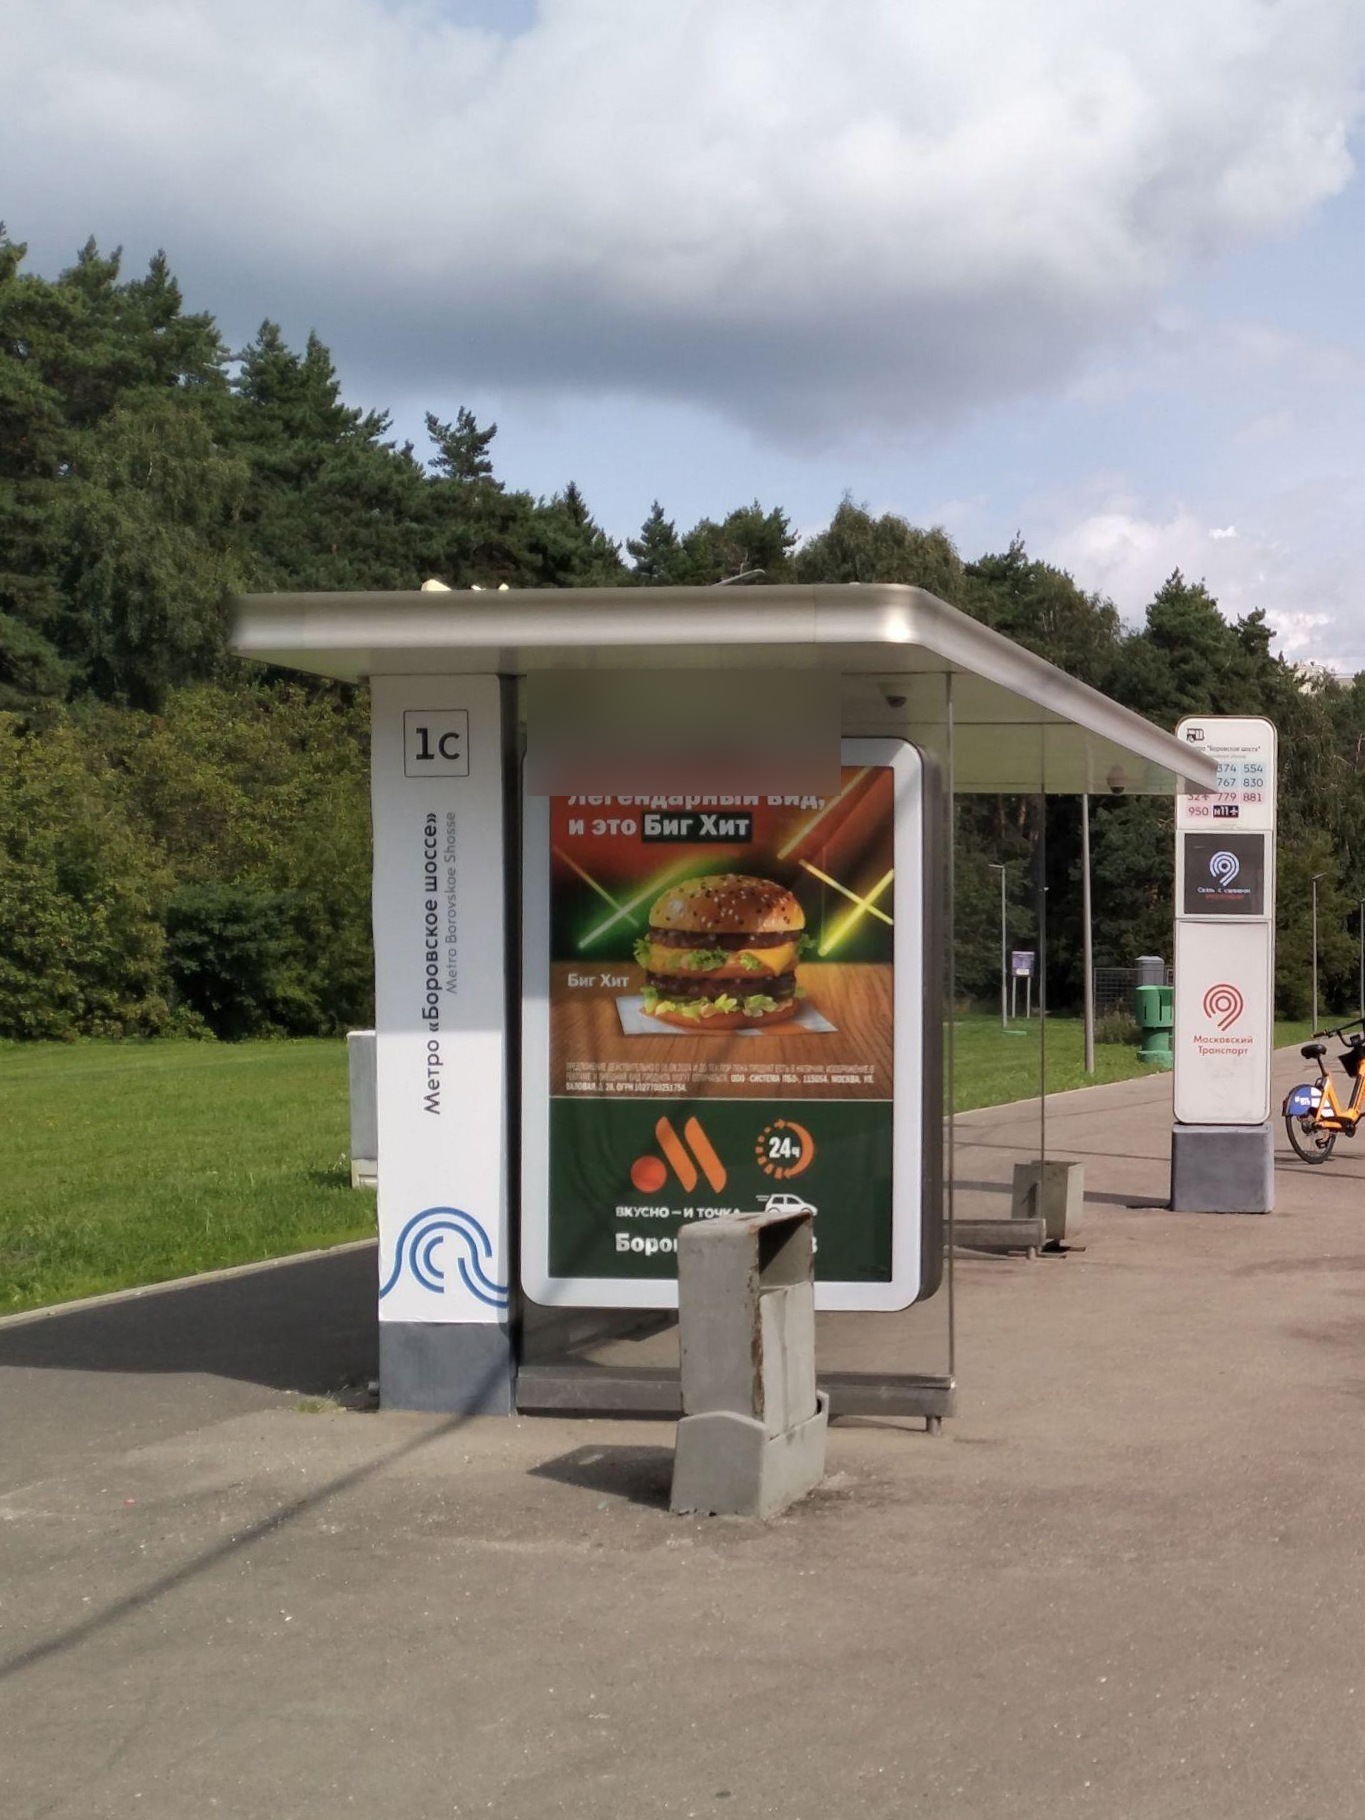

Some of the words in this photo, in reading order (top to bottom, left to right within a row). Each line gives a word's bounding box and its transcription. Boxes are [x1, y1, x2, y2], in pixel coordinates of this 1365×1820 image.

[1243, 764, 1263, 773] 554
[1217, 778, 1236, 787] 767
[1243, 778, 1264, 787] 830
[1218, 792, 1237, 801] 779
[1243, 793, 1263, 802] 881
[1188, 806, 1209, 816] 950
[568, 819, 584, 835] и
[591, 819, 637, 835] это
[644, 814, 693, 835] Биг
[699, 814, 750, 835] Хит
[444, 812, 456, 863] Shosse
[424, 812, 438, 892] шоссе»
[444, 867, 457, 944] Borovskoe
[422, 899, 442, 1032] «Боровское
[446, 949, 457, 995] Metro
[568, 973, 596, 987] Биг
[600, 973, 630, 987] Хит
[1193, 1035, 1254, 1044] Московский
[1198, 1045, 1248, 1056] Транспорт
[424, 1039, 443, 1115] Метро
[769, 1136, 800, 1158] 24ч
[615, 1206, 670, 1218] ВКУСНО
[683, 1207, 693, 1218] И
[616, 1233, 678, 1256] Боро
